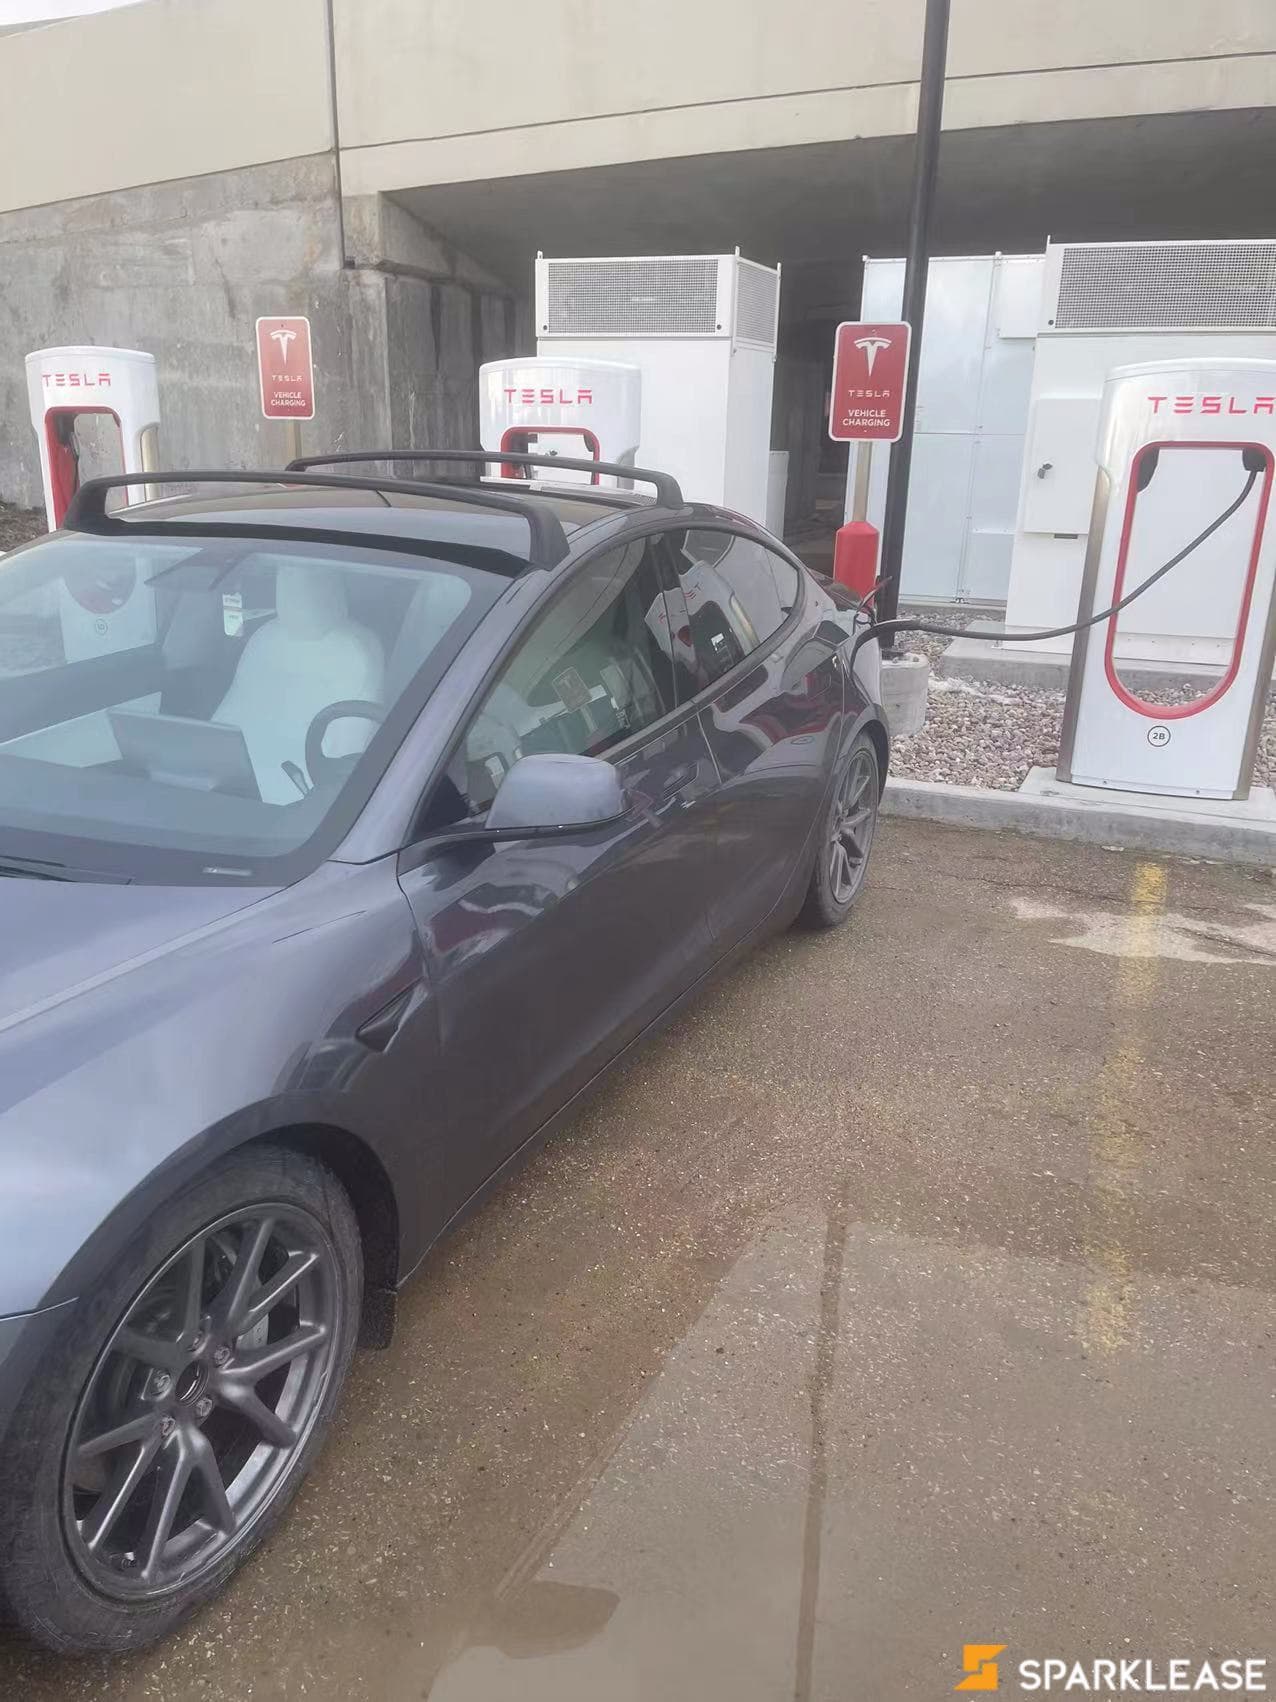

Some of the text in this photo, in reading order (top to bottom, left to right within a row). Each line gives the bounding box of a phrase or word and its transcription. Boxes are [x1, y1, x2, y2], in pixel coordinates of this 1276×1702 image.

[42, 373, 112, 387] TESLA
[271, 374, 303, 382] TESLA
[273, 391, 302, 399] VEHICLE
[503, 388, 593, 405] TESLA
[847, 389, 890, 398] TESLA
[270, 399, 306, 407] CHARGING
[1147, 396, 1276, 415] TESLA
[848, 409, 886, 418] VEHICLE
[842, 418, 891, 427] CHARGING
[1152, 732, 1166, 740] 2B
